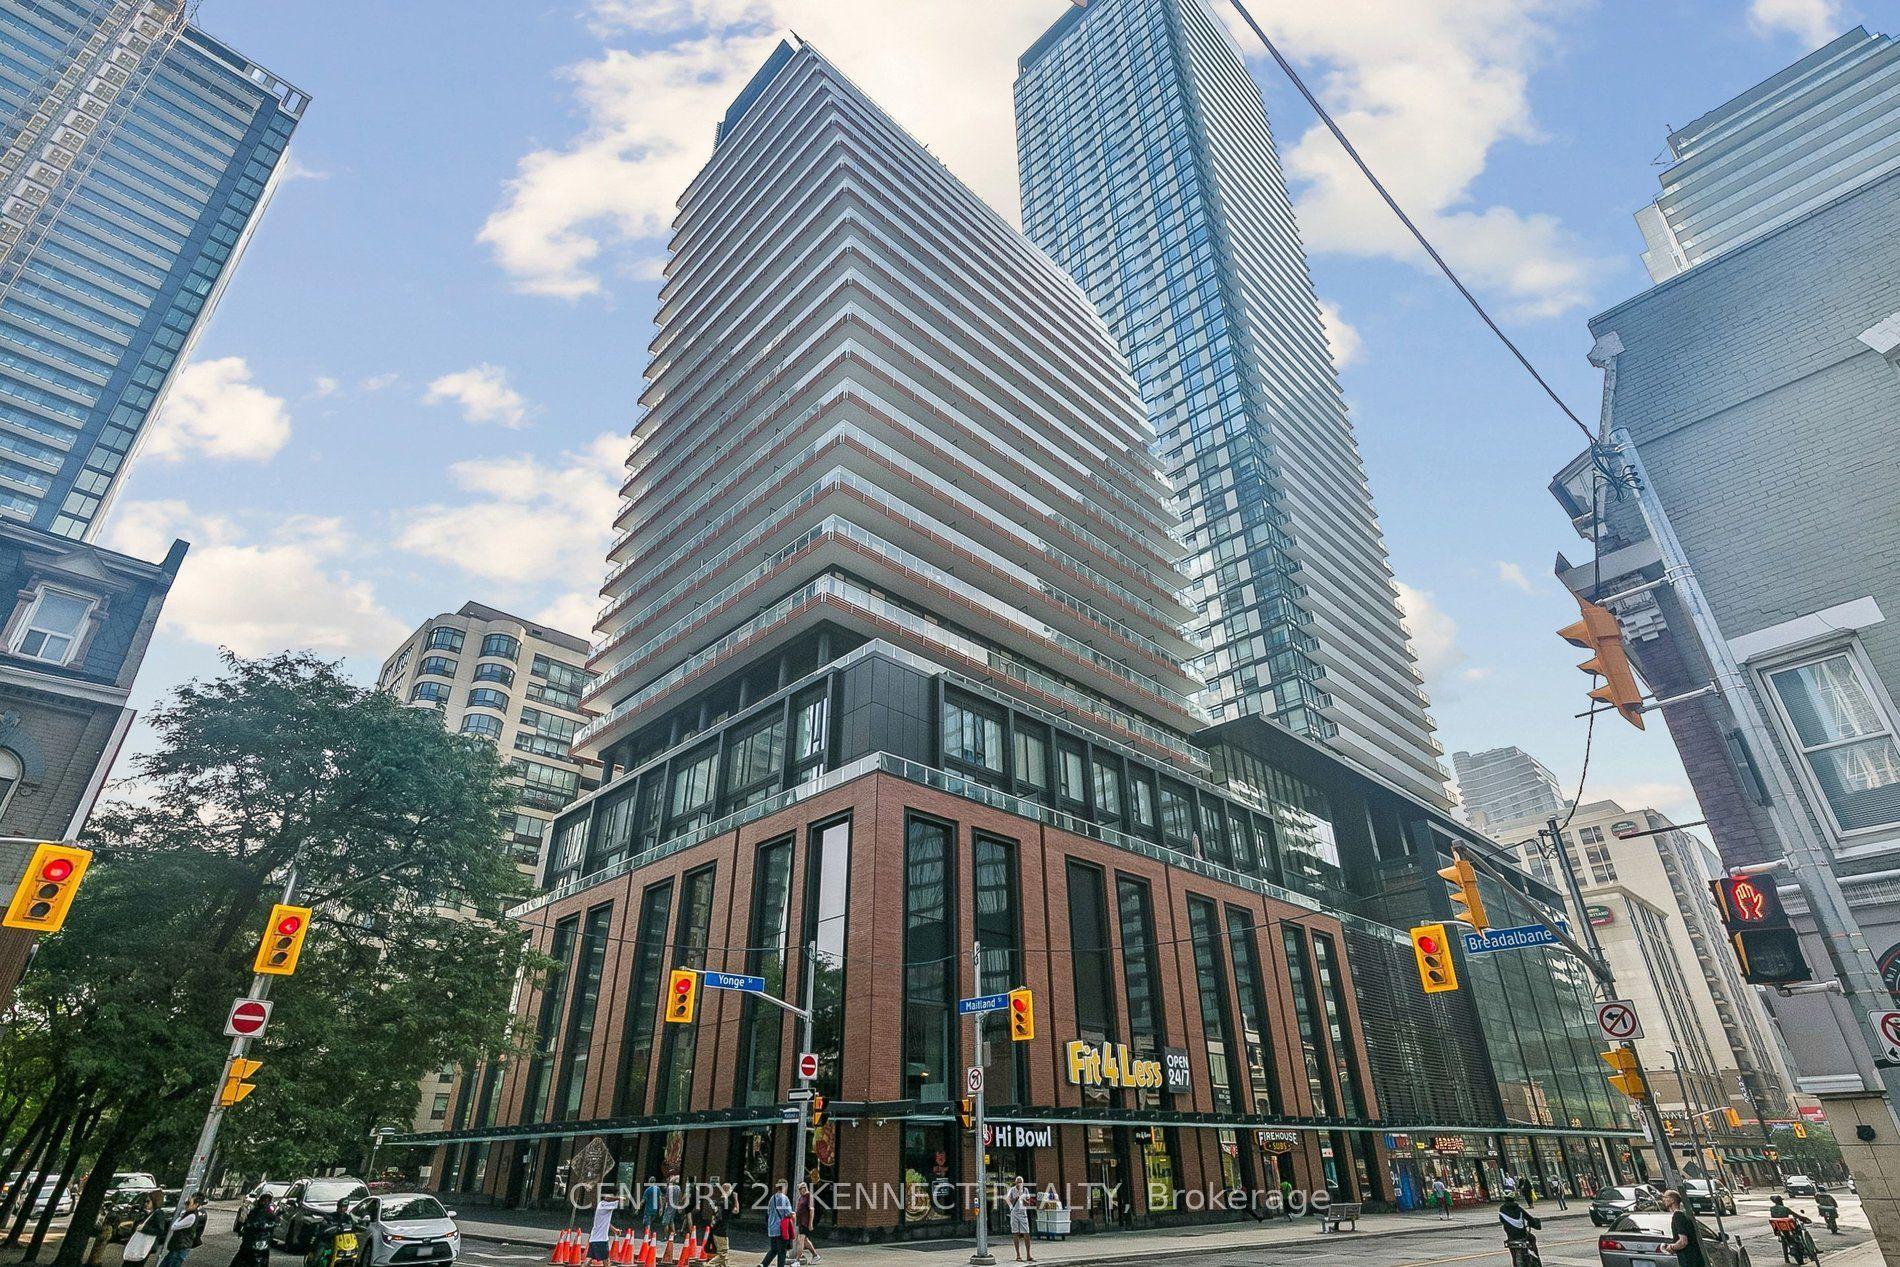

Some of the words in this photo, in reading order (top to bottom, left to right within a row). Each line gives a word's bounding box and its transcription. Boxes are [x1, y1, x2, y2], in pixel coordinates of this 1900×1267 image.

[1468, 929, 1553, 951] Breadalbane
[718, 974, 745, 989] Yonge
[965, 998, 996, 1011] Maitland
[1166, 1054, 1189, 1069] OPEN
[1168, 1068, 1190, 1086] 24/7
[995, 1125, 1012, 1147] Hi
[1015, 1126, 1052, 1147] Bowl
[1258, 1131, 1298, 1146] FIREHOUSE
[1272, 1142, 1288, 1150] SUBS
